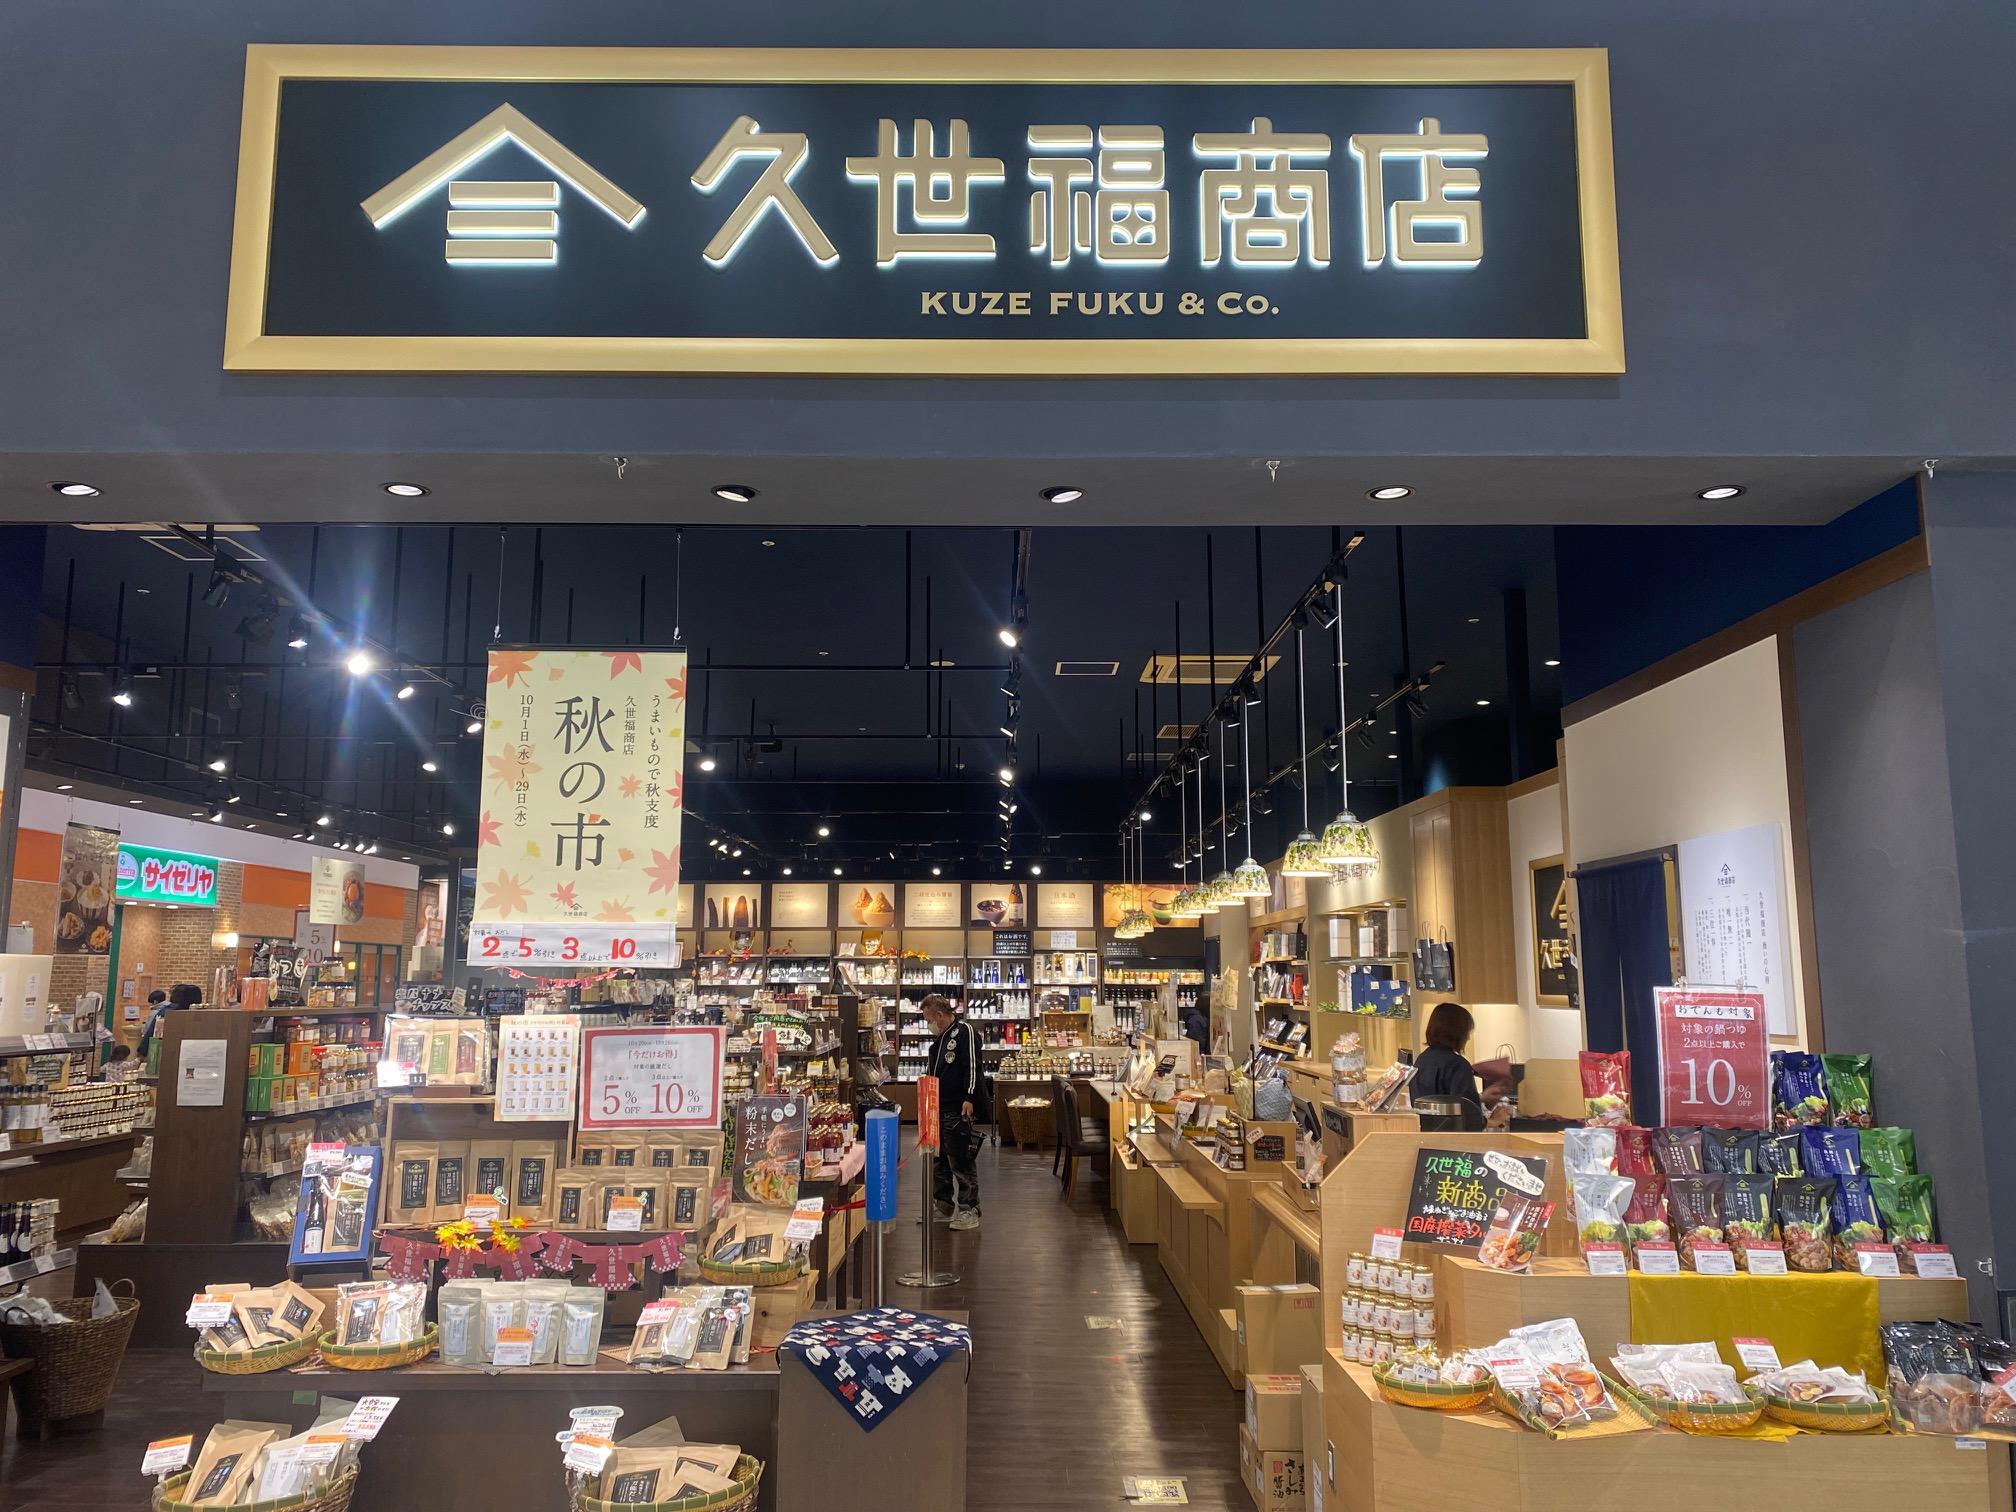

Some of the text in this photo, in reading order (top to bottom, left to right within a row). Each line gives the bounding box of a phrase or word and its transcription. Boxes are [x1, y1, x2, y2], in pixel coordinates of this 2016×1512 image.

[690, 116, 1490, 270] 久世福商店
[920, 293, 1032, 317] KUZE
[1048, 293, 1165, 317] FUKU
[1176, 293, 1207, 317] &
[621, 695, 638, 756] 久世福商店
[643, 694, 662, 830] うまいもので秋支度
[550, 695, 615, 872] 秋の市
[142, 858, 214, 898] サイゼリヤ
[1678, 1006, 1753, 1019] おでんも対象
[1681, 1023, 1747, 1036] 対象の鍋つゆ
[1683, 1037, 1746, 1049] 2点以上ご購入で
[603, 1084, 621, 1115] 5
[650, 1083, 684, 1114] 10
[1680, 1058, 1751, 1106] 10 %
[744, 1105, 758, 1166] 粉末だし
[879, 1126, 887, 1210] このままお進みください
[1425, 1156, 1488, 1178] 久世福の
[403, 1241, 414, 1274] 久世福祭
[608, 1247, 616, 1282] 久世福祭
[659, 1238, 671, 1265] 久世福祭
[1284, 1458, 1299, 1496] さしみ
